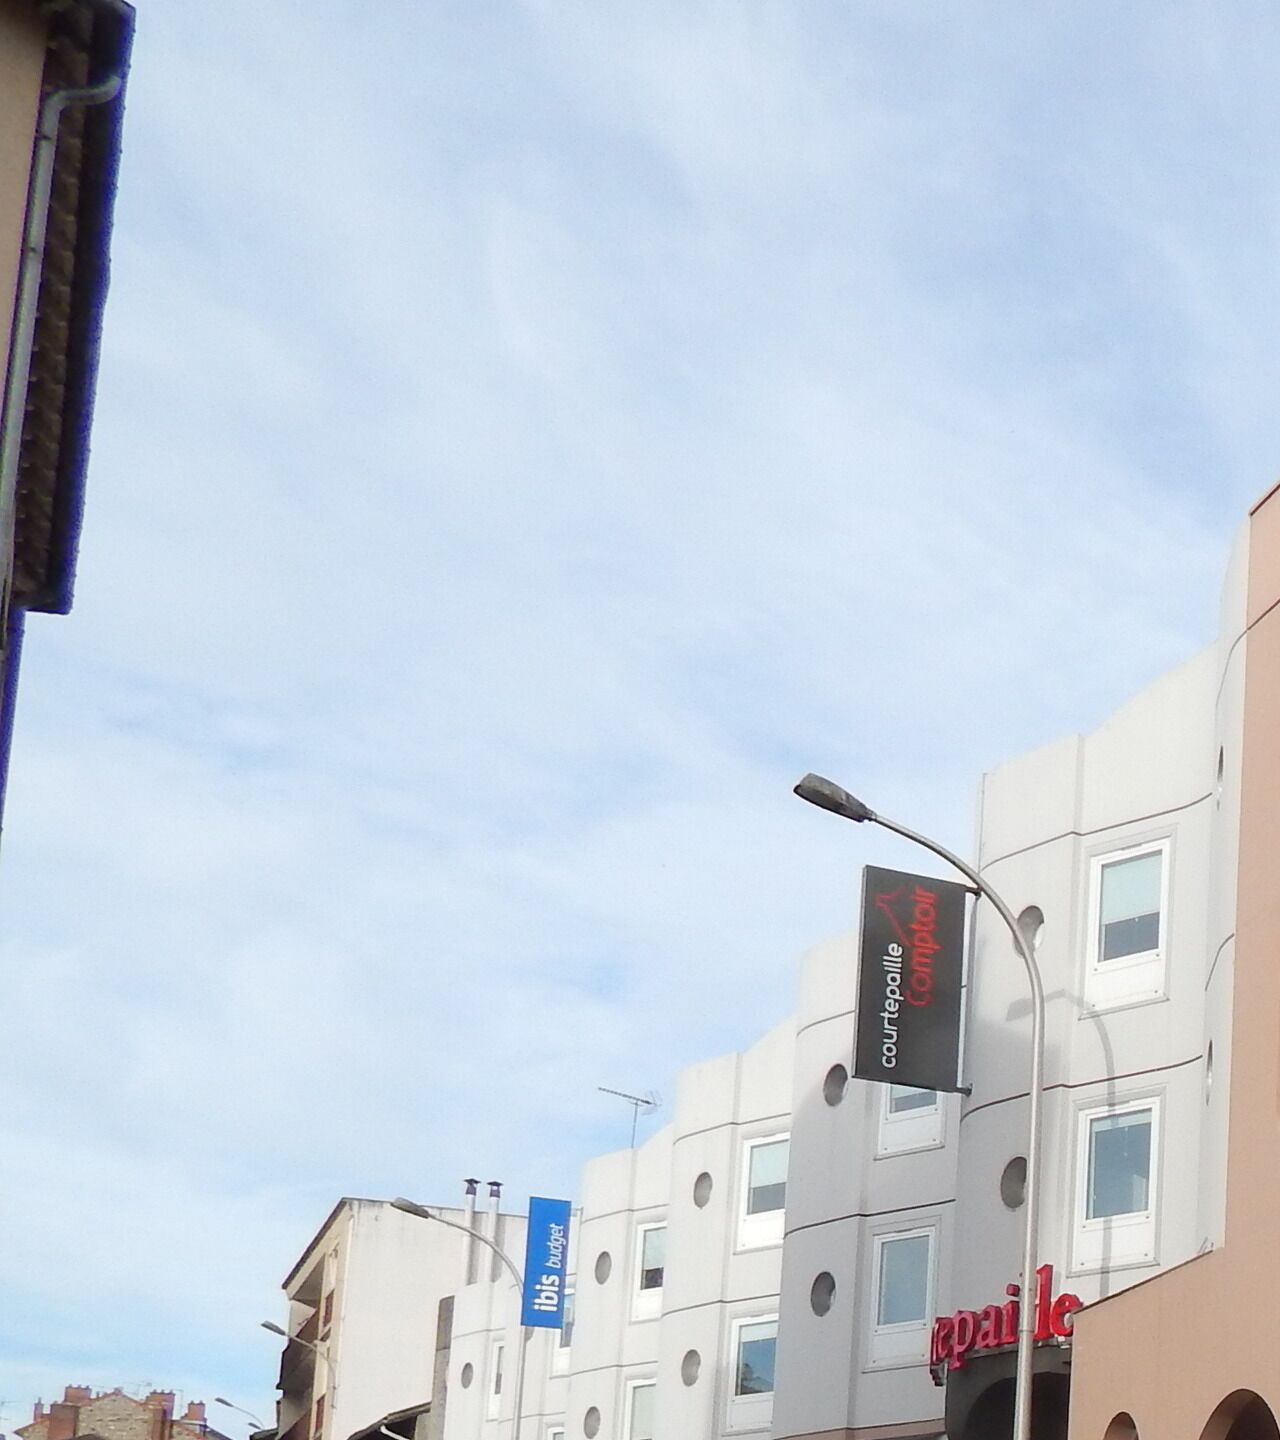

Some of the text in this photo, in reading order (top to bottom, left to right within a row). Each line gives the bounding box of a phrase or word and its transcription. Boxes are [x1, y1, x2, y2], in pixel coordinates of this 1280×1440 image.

[879, 942, 905, 1069] courtepaille
[533, 1223, 566, 1311] ibis budget
